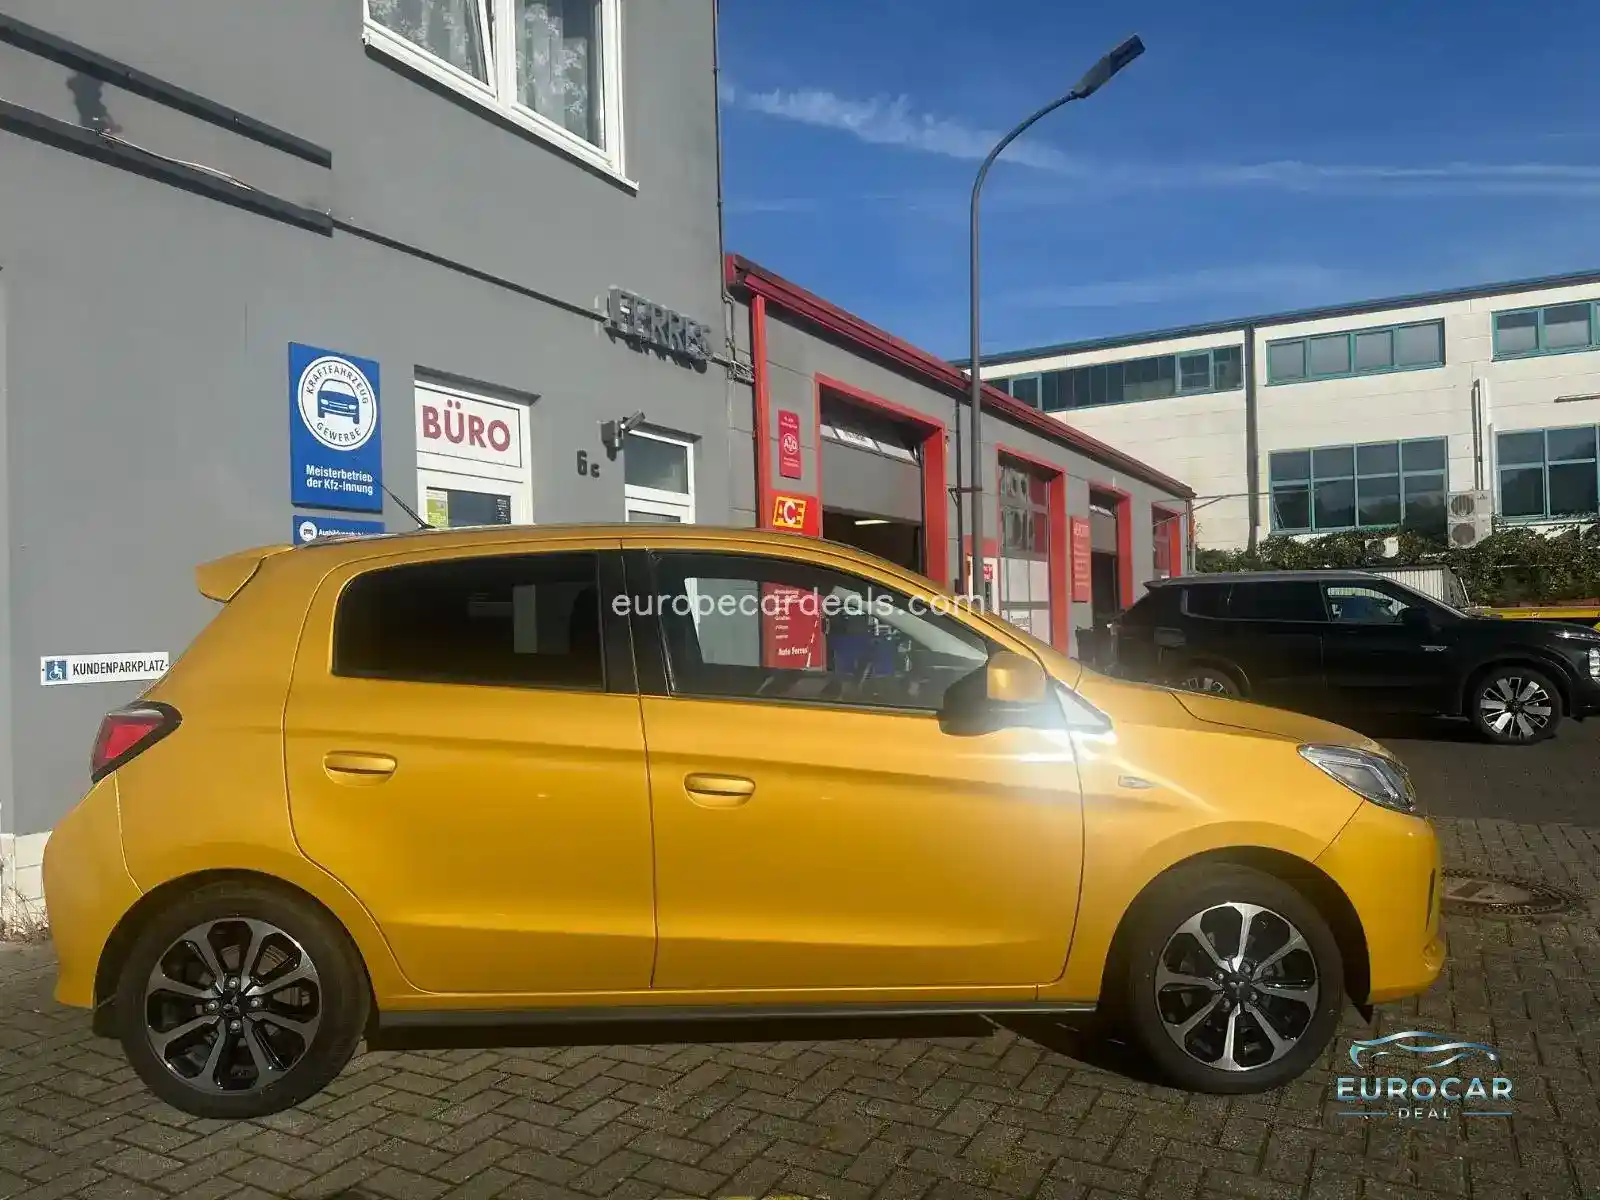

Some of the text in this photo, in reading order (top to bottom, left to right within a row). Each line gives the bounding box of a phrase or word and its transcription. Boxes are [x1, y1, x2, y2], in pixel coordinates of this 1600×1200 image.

[306, 365, 369, 404] KRAFTFAHRZEUG
[317, 422, 361, 442] GEWERBE
[422, 399, 511, 452] BÜRO
[305, 464, 373, 483] Meisterbetrieb
[306, 477, 373, 496] der Kfz-Innung
[774, 497, 806, 528] ACE
[72, 659, 165, 676] KUNDENPARKPLATZ
